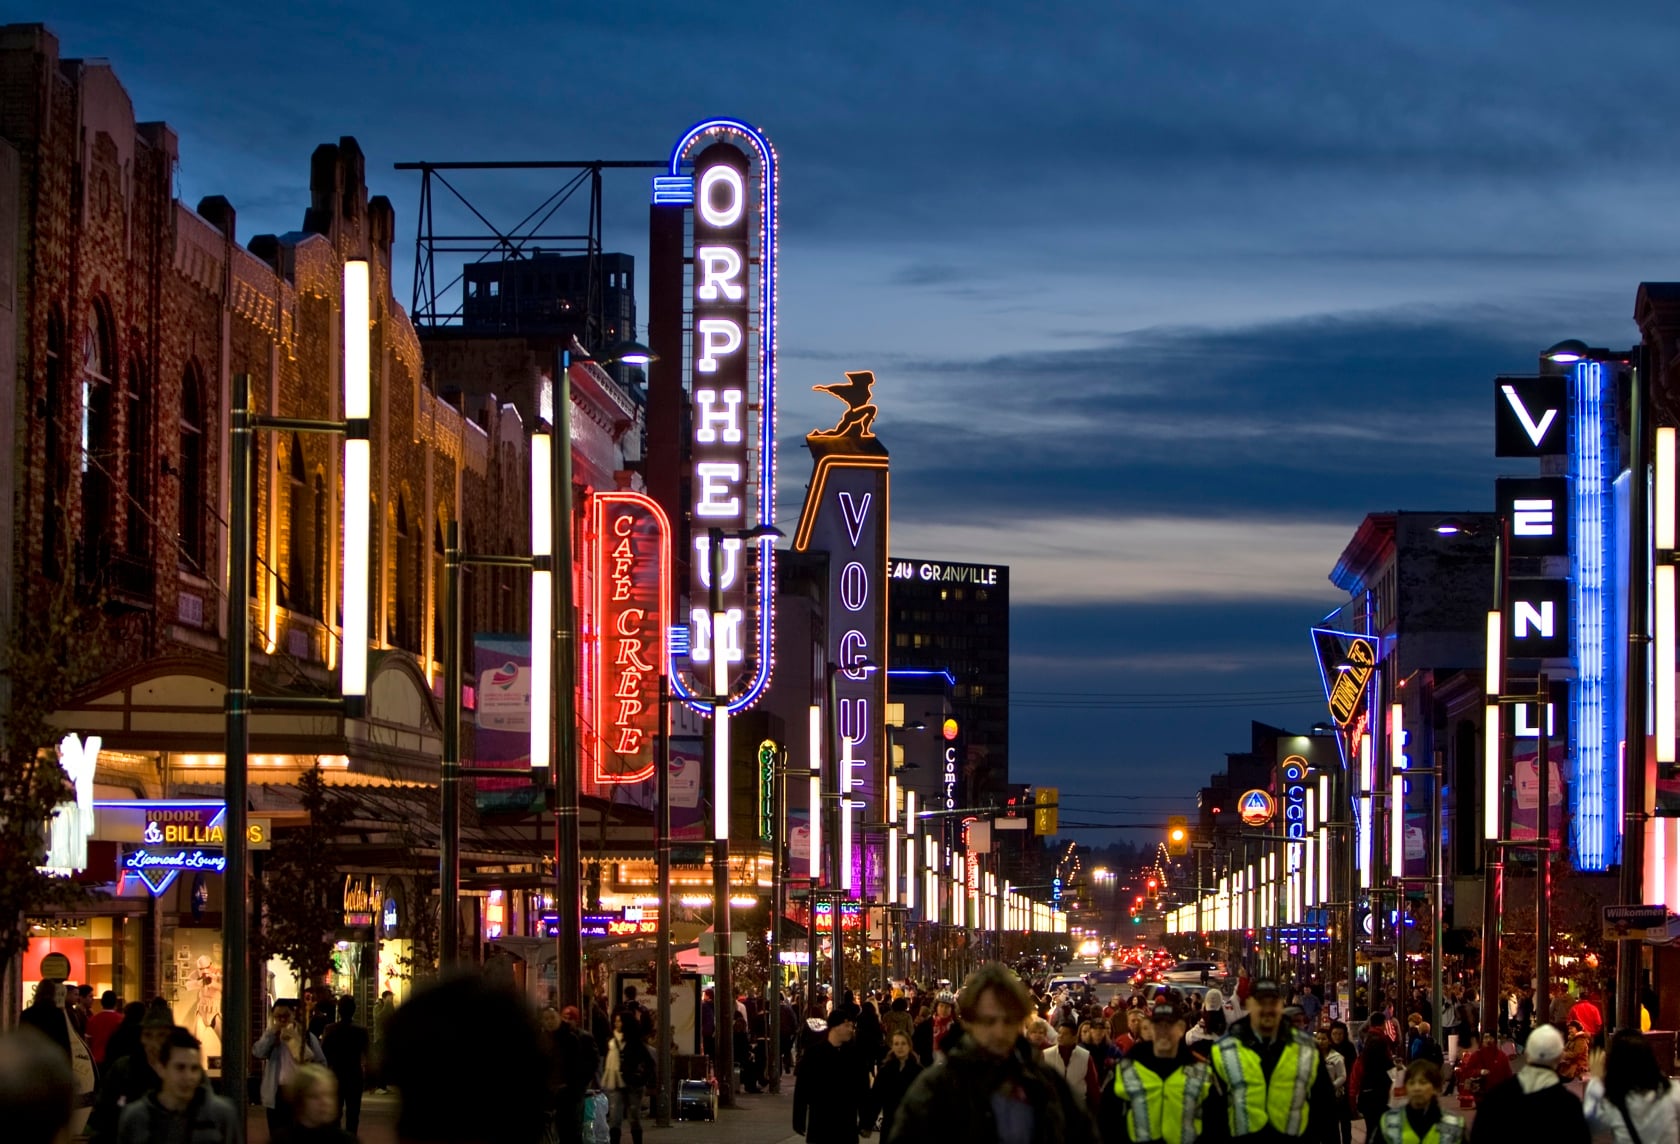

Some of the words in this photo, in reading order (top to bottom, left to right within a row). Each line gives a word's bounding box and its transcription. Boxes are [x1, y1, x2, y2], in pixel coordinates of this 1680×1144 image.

[692, 165, 742, 662] ORPHEUM
[612, 515, 635, 601] CAFÉ
[920, 563, 997, 585] GRANVILLE
[839, 491, 872, 808] VOGUE
[614, 608, 653, 755] CRÊPE
[1331, 671, 1359, 718] TOM
[144, 822, 163, 843] &
[165, 824, 264, 842] BILLIAS
[185, 850, 226, 871] Loung
[1607, 907, 1665, 918] Willkommen
